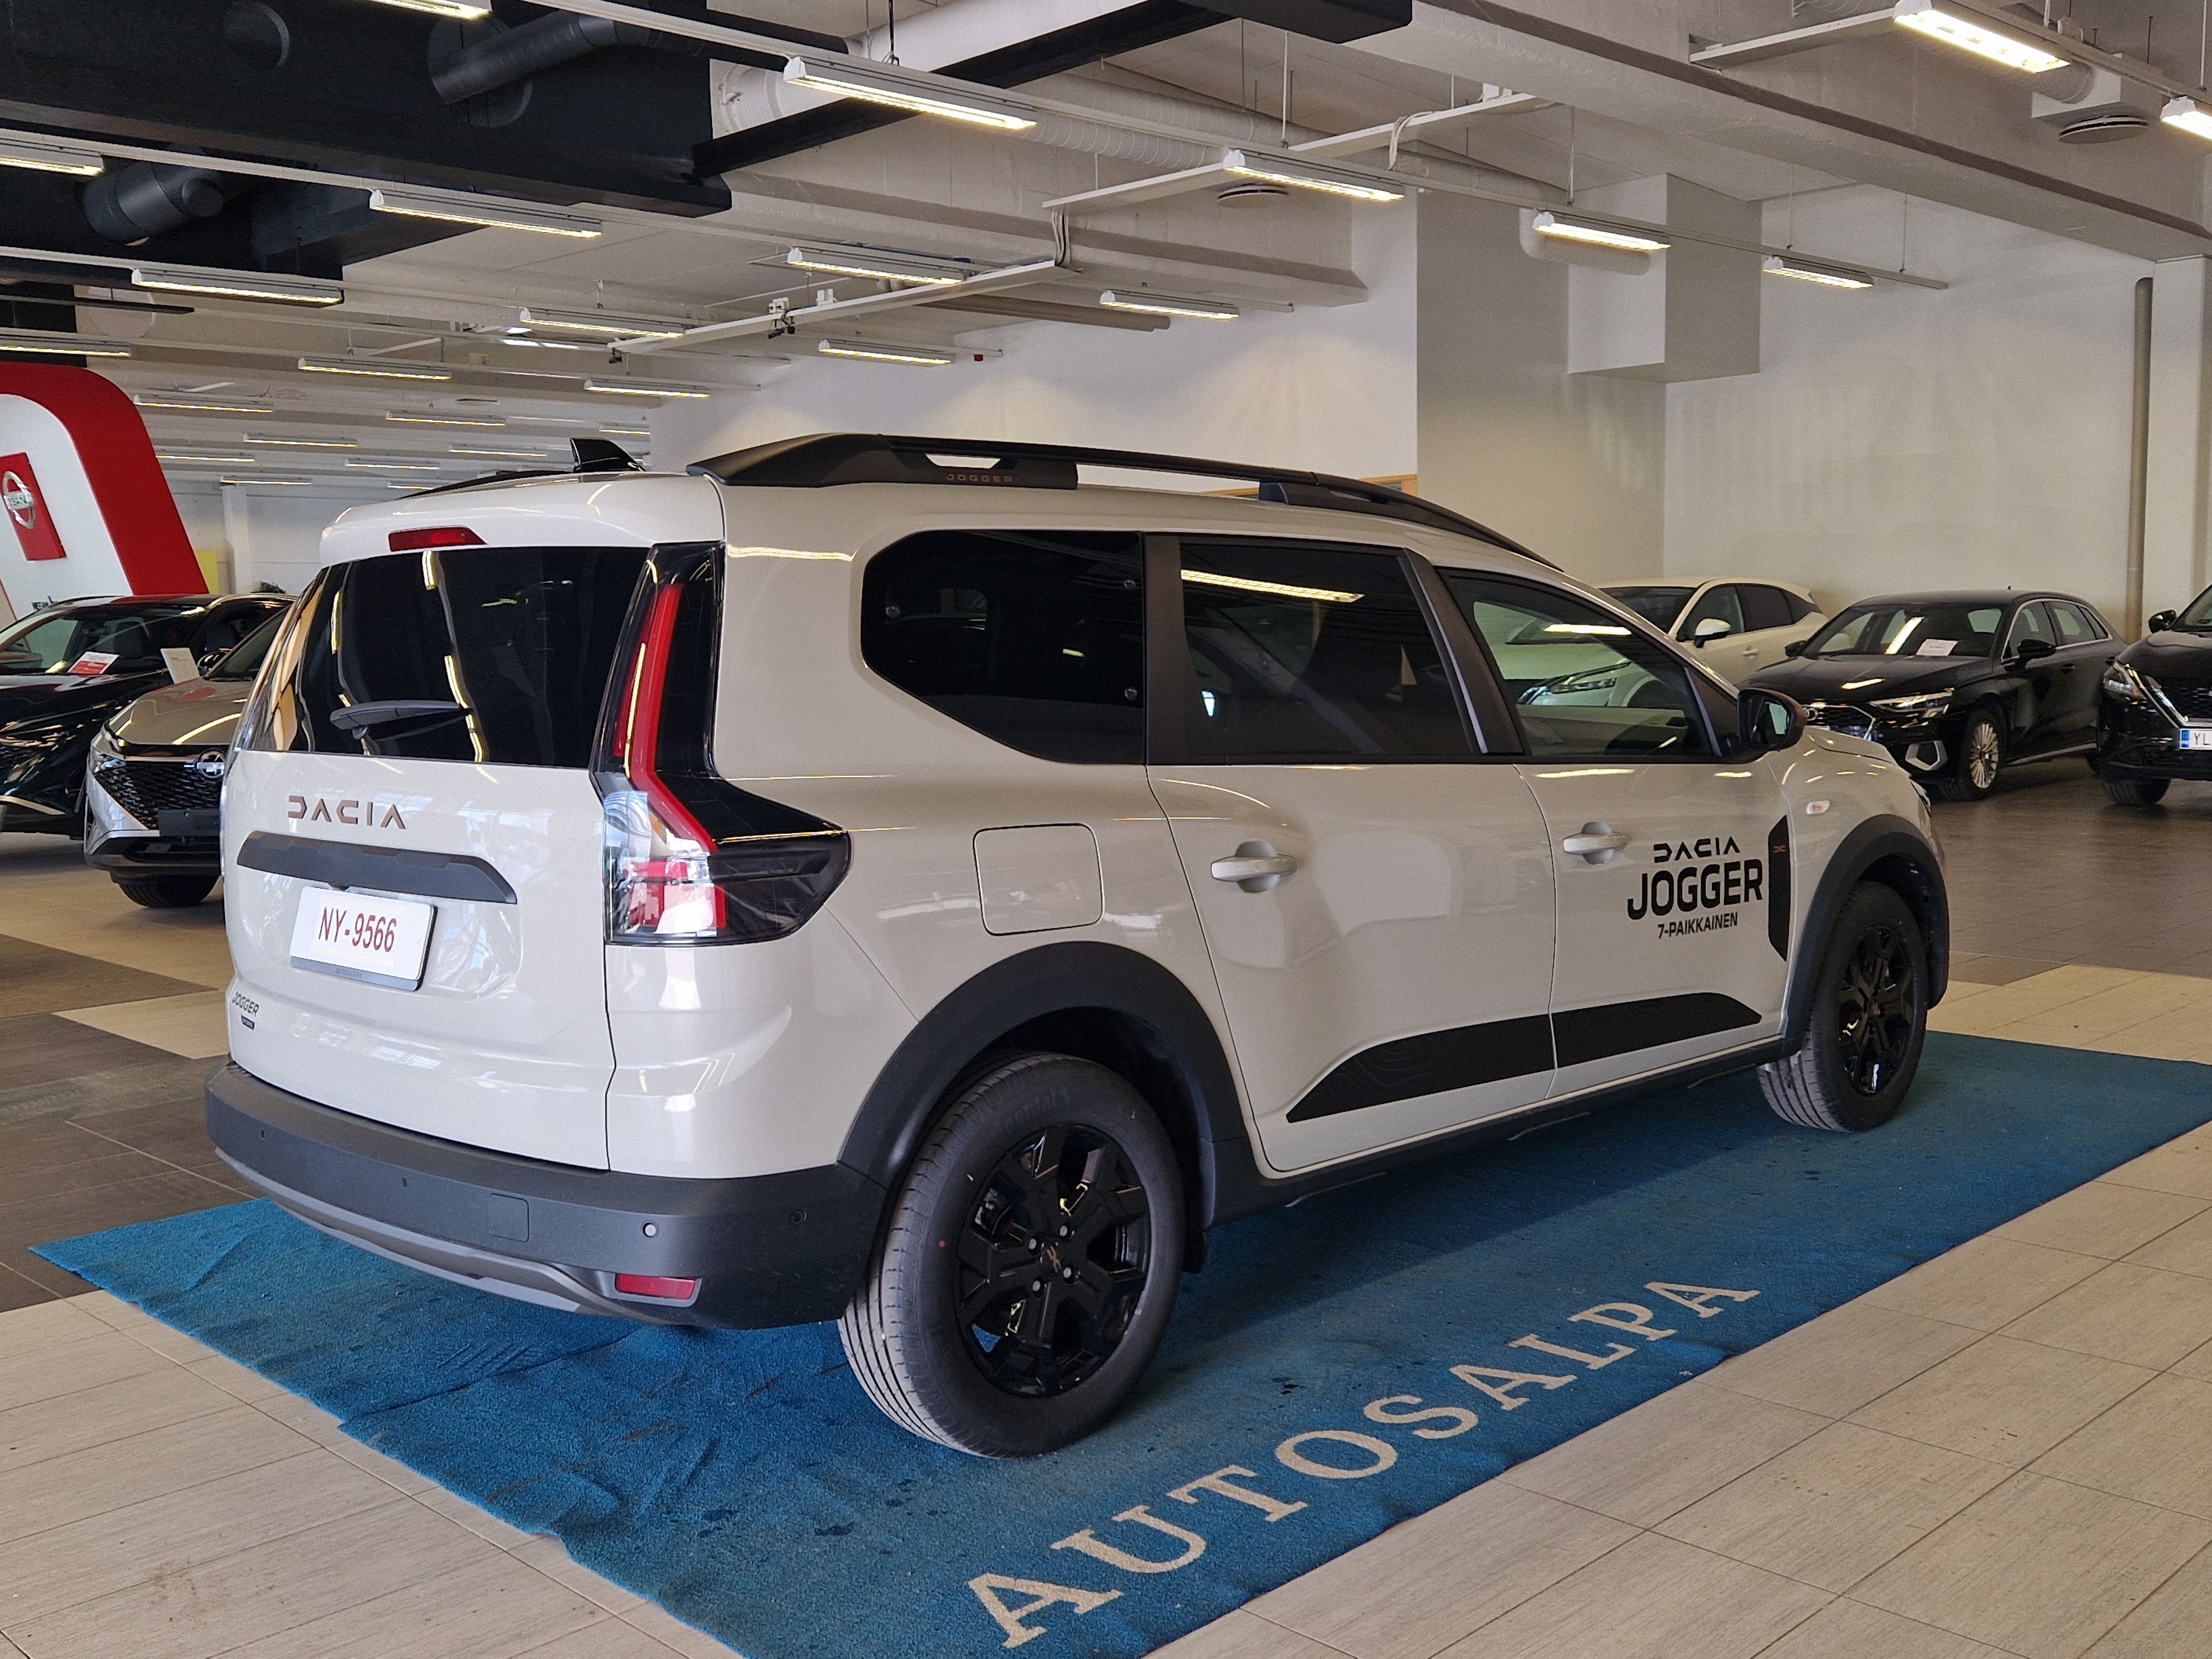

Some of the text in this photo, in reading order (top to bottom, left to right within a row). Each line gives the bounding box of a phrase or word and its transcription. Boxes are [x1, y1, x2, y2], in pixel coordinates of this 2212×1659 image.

[946, 474, 1012, 482] JOGGER
[288, 795, 406, 829] DACIA
[1653, 836, 1740, 863] DACIA
[1627, 859, 1763, 920] JOGGER
[319, 907, 397, 952] NY-9566
[1658, 912, 1738, 939] 7-PAIKKAINEN
[232, 992, 259, 1017] JOGGER
[967, 1280, 1762, 1648] AUTOSALPA
